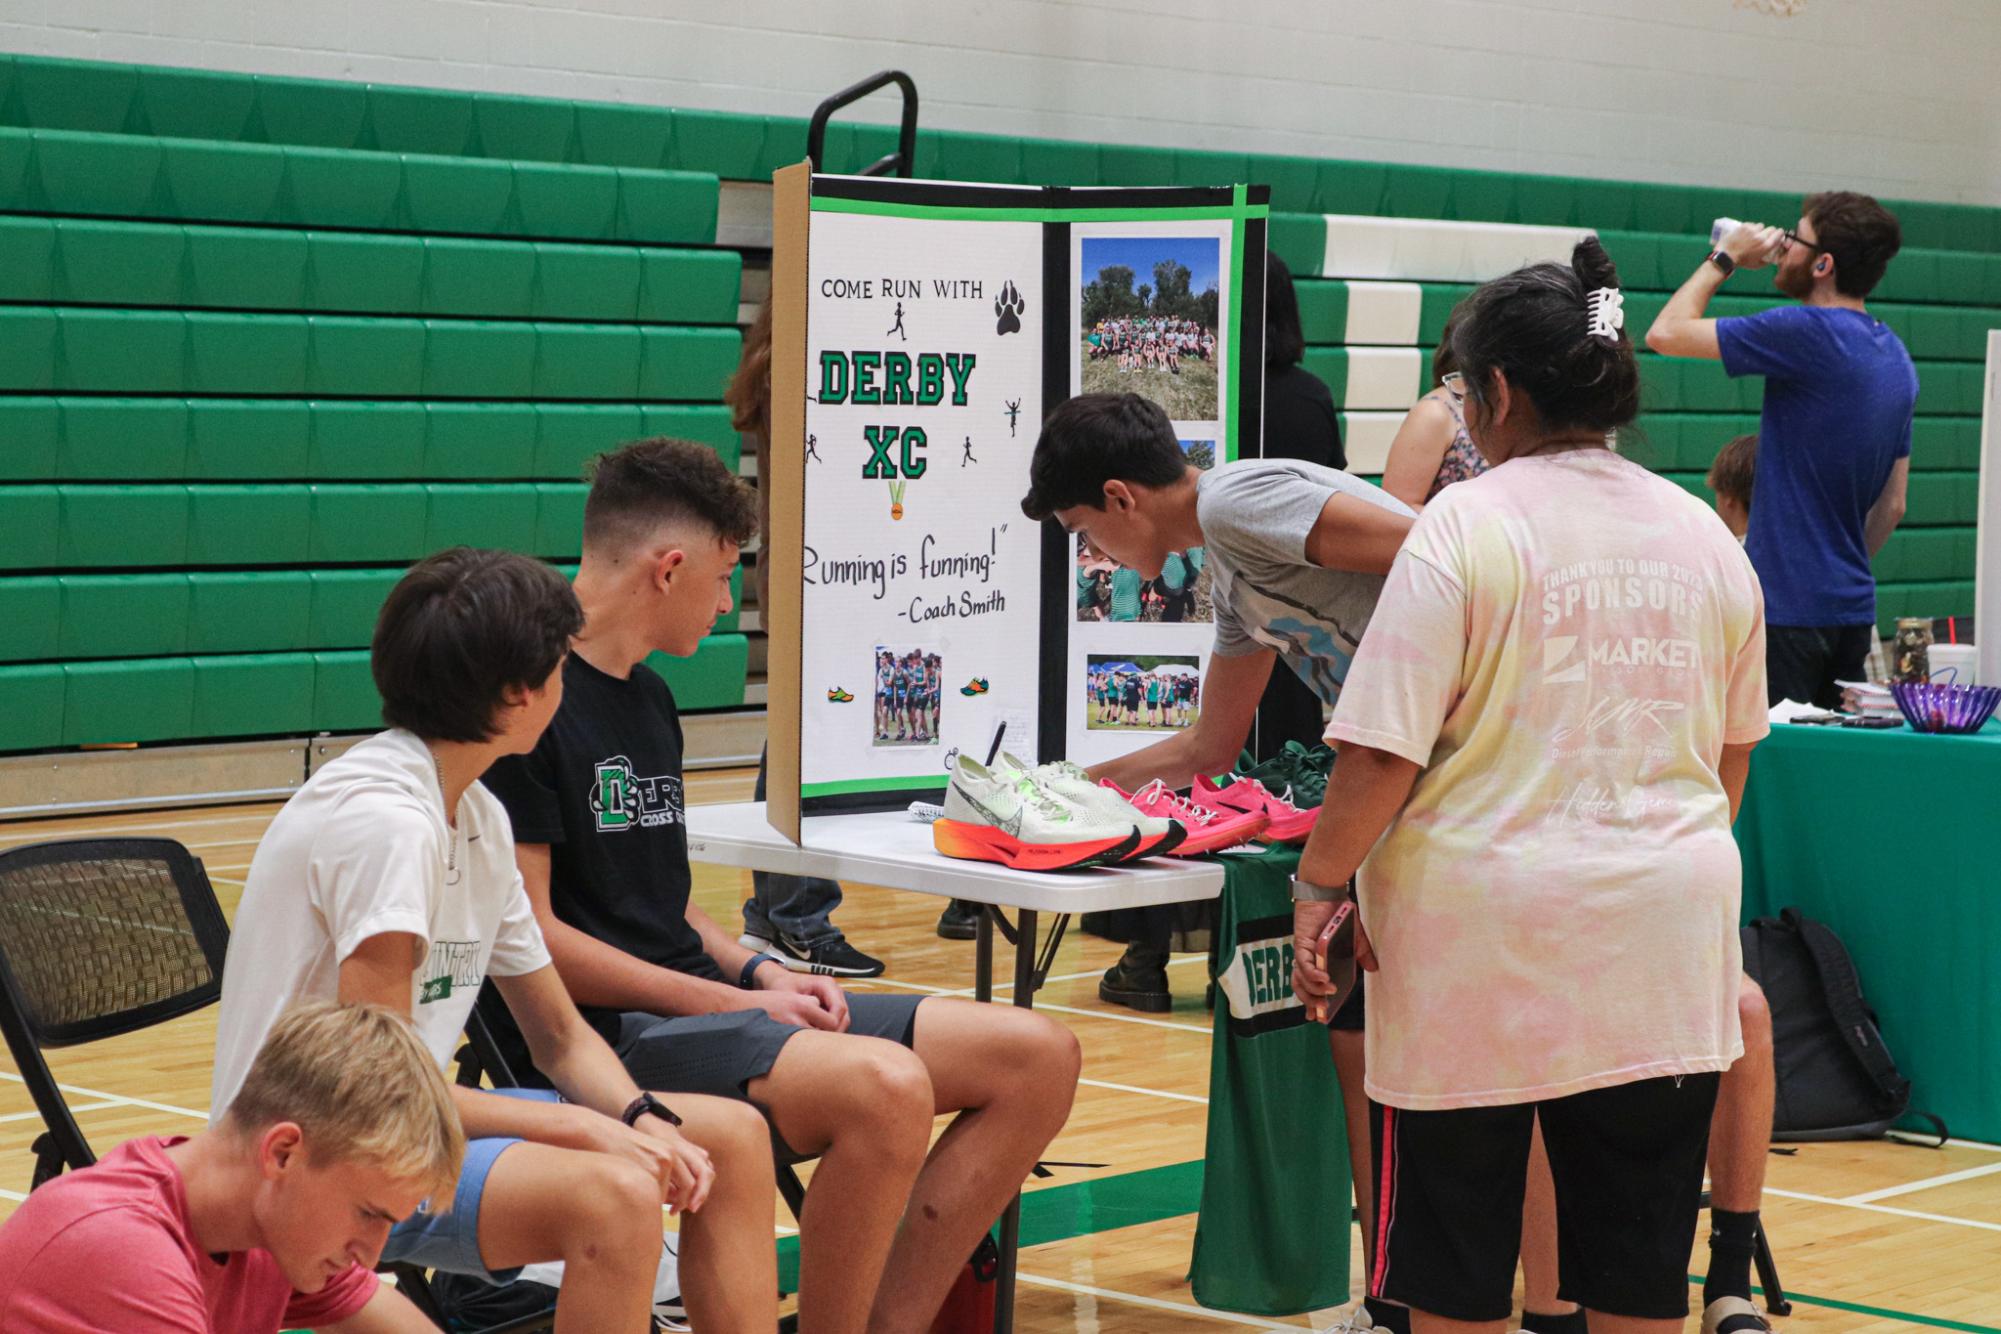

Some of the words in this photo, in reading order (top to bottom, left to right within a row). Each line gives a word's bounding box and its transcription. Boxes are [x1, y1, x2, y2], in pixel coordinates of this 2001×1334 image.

[821, 279, 873, 299] COME
[881, 278, 921, 299] RUN
[933, 280, 983, 299] WITH
[818, 350, 976, 406] DERBY
[862, 425, 927, 479] XC
[890, 553, 907, 579] is
[1543, 562, 1588, 592] THANK
[1590, 558, 1614, 576] YOU
[1616, 558, 1634, 574] TO
[1639, 559, 1669, 578] OUR
[958, 589, 1005, 618] Smith
[1542, 576, 1704, 626] SPONSORS
